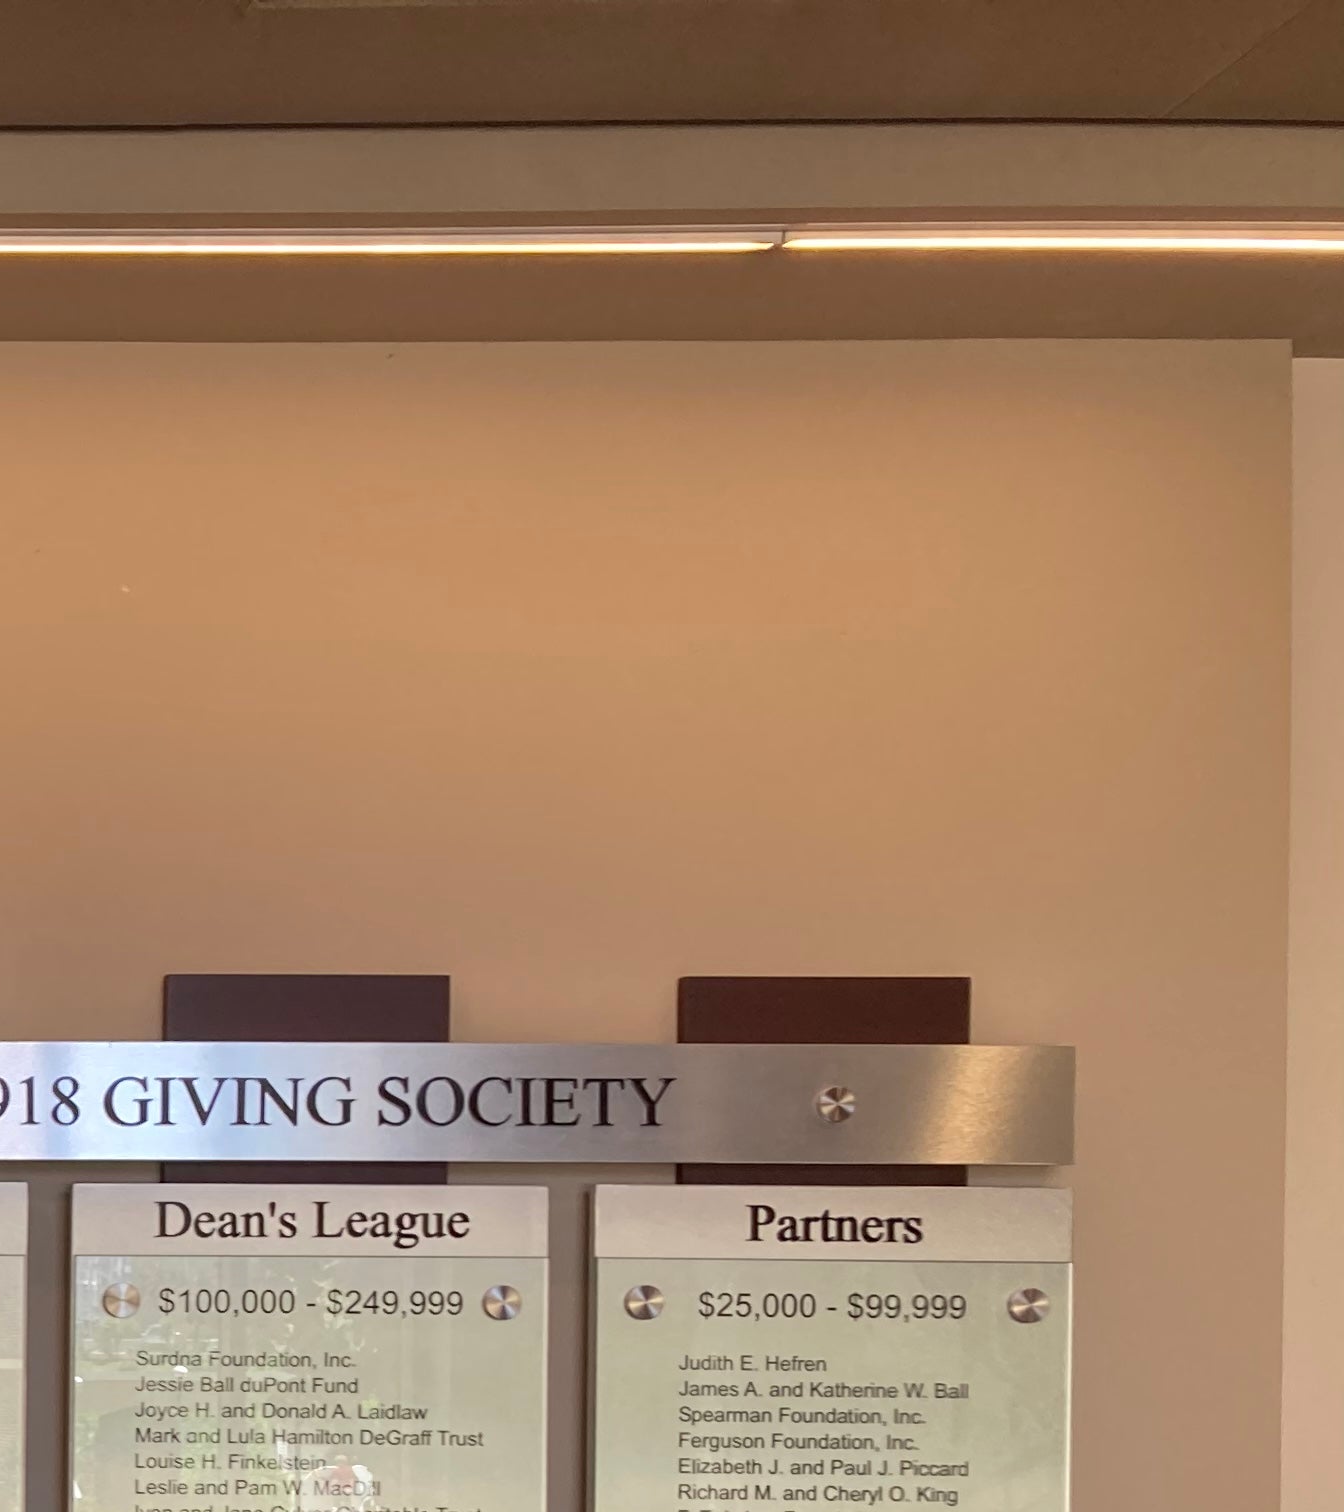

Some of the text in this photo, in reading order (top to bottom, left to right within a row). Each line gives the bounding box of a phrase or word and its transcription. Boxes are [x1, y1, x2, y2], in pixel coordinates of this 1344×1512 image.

[103, 1076, 356, 1128] GIVING
[378, 1076, 677, 1128] SOCIETY
[154, 1200, 470, 1250] Dean's League
[745, 1204, 924, 1244] Partners
[158, 1287, 296, 1318] $100,000
[326, 1288, 464, 1319] $249,999
[698, 1291, 816, 1322] $25,000
[847, 1292, 966, 1323] $99,999
[678, 1354, 827, 1372] Judith E. Hefren
[134, 1376, 359, 1394] Jessie Ball duPont Fund
[134, 1402, 428, 1422] Joyce H. and Donald A. Laidlaw
[678, 1405, 926, 1427] Spearman Foundation, Inc.
[678, 1431, 920, 1453] Ferguson Foundation, Inc.
